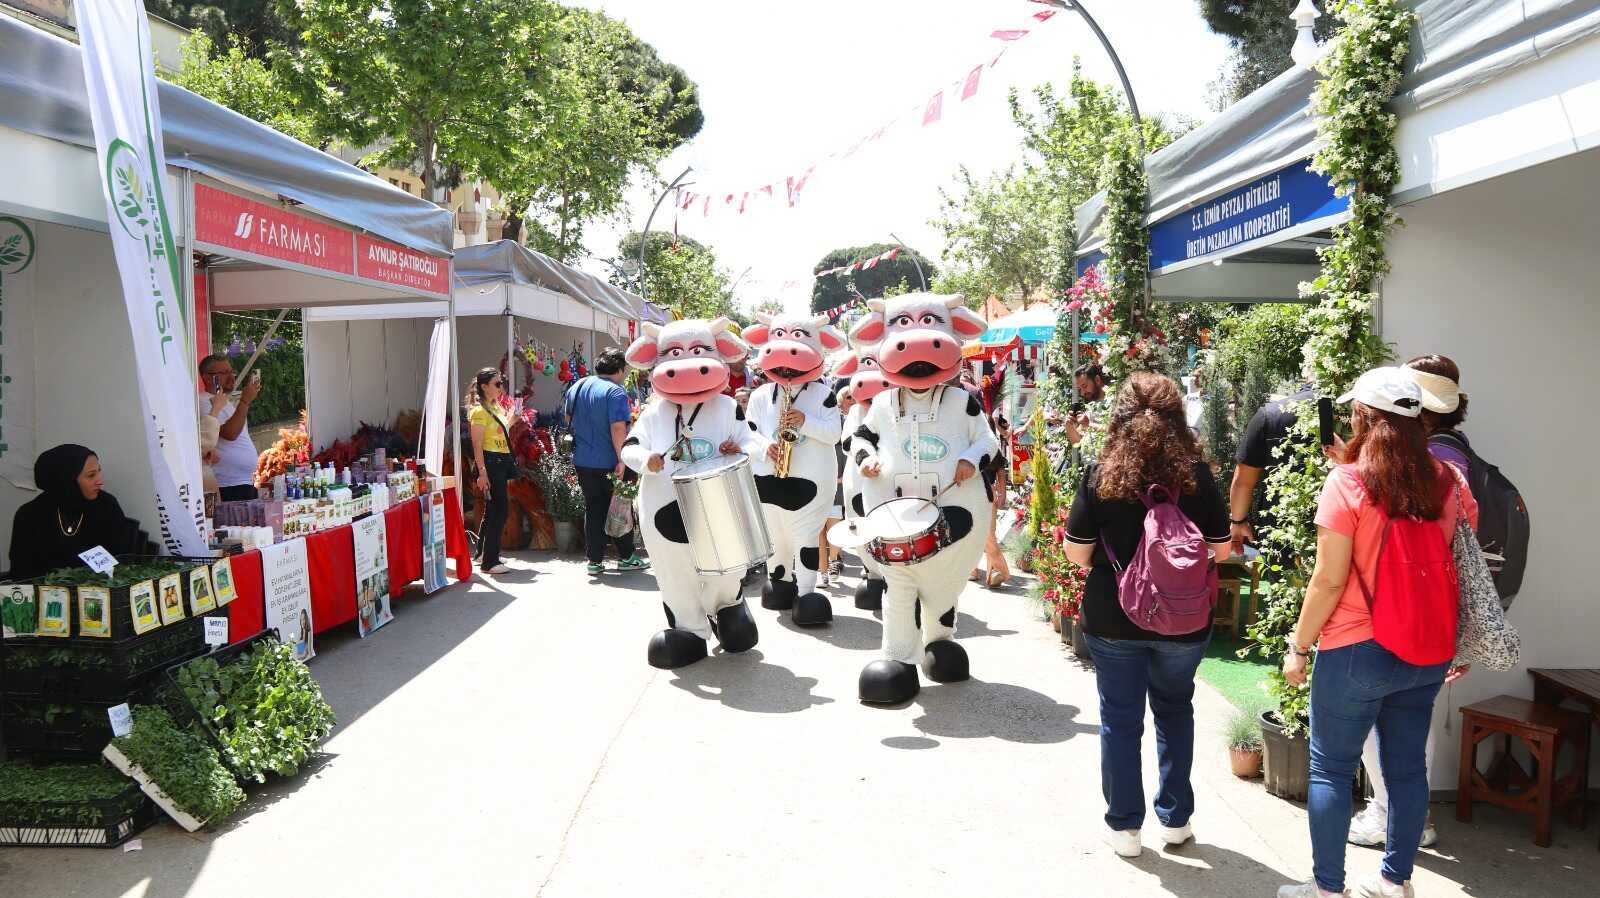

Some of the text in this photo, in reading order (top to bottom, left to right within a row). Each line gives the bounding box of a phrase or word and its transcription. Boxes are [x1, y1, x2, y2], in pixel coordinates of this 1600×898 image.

[1186, 202, 1290, 259] ÜRETİM PAZARLAMA KOOPERATİFİ
[1192, 175, 1281, 231] S.S. İZMİR PEYZAJ BİTKİLERİ
[368, 244, 438, 277] AYNUR ŞATIROĞLU
